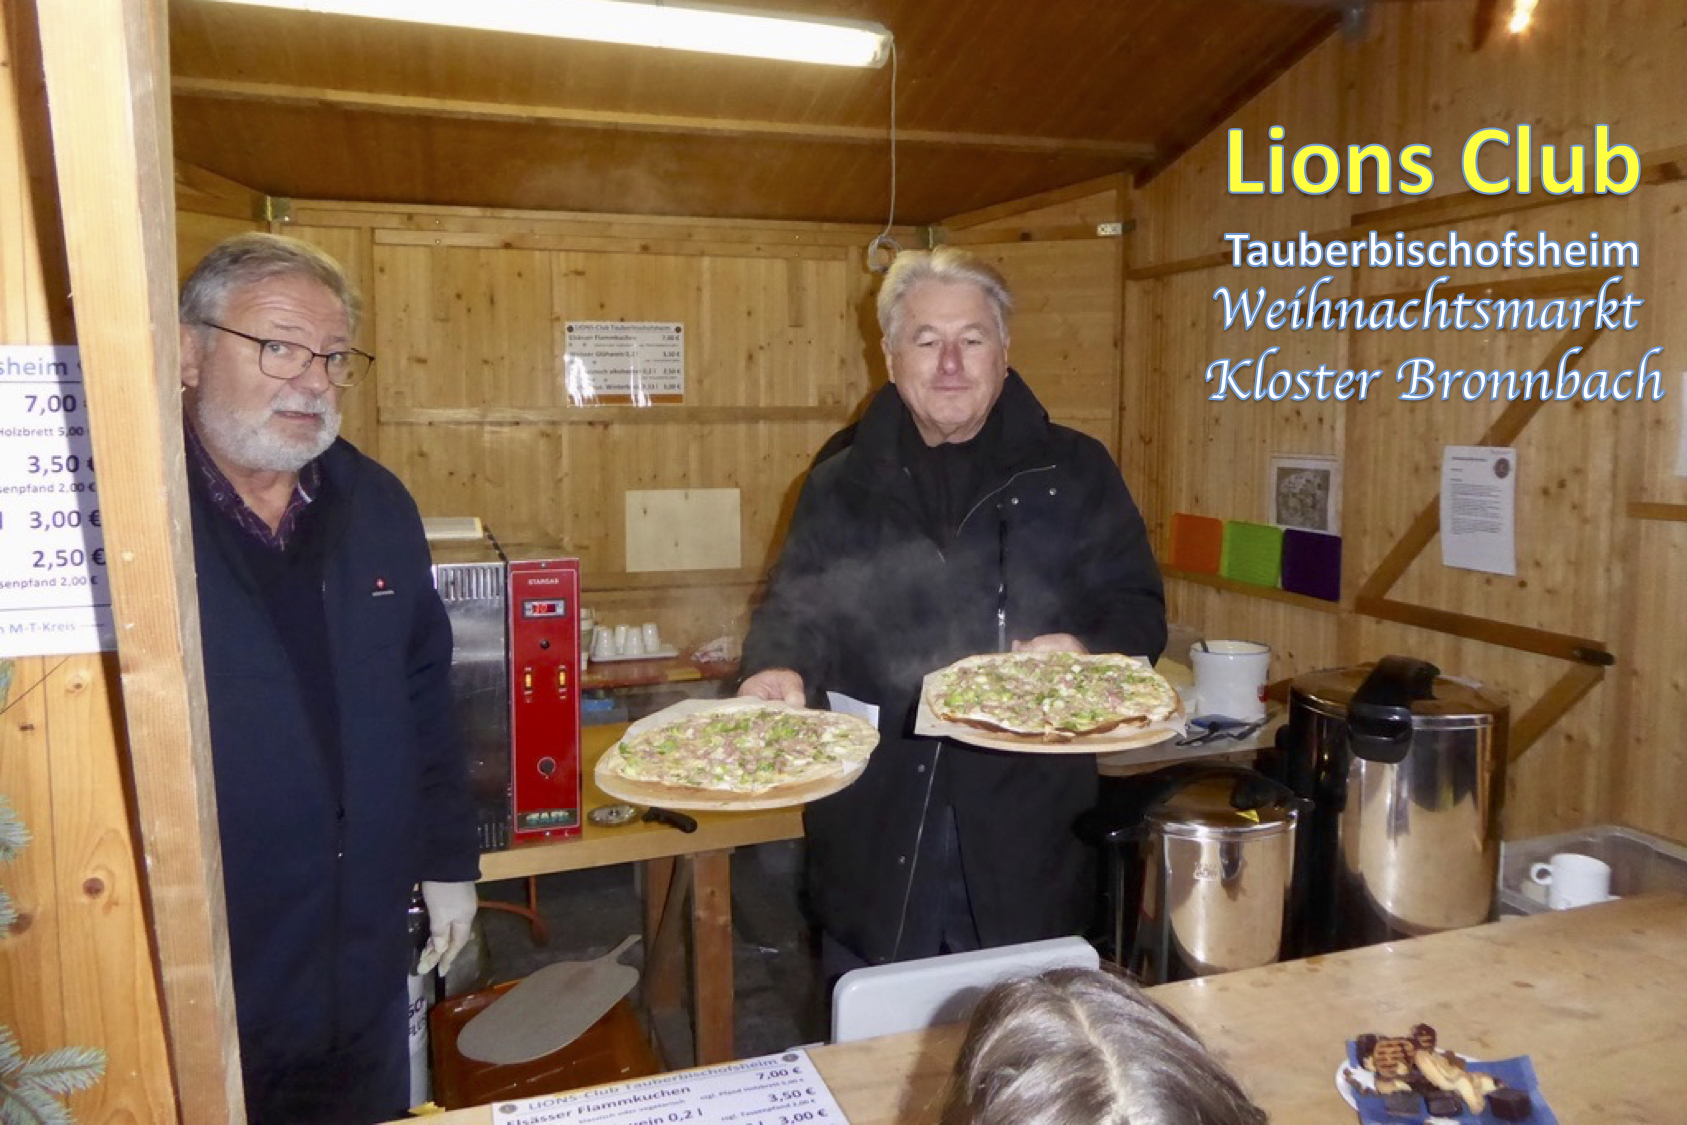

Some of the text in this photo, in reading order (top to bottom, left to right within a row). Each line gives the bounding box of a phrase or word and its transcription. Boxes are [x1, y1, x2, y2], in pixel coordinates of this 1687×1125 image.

[25, 394, 76, 416] 7,00
[58, 427, 84, 437] 5,00
[28, 455, 80, 476] 3,50
[59, 483, 84, 493] 2,00
[30, 510, 81, 532] 3,00
[89, 510, 101, 527] €
[33, 548, 106, 571] 2,50 €
[61, 577, 86, 588] 2,00
[91, 576, 98, 585] €
[10, 622, 76, 634] M-T-Kreis
[627, 1058, 778, 1090] Tauberbischofsheim
[578, 1085, 691, 1114] Flammkuchen
[756, 1068, 789, 1080] 7,00
[793, 1066, 803, 1074] €
[668, 1109, 692, 1122] 0,2
[768, 1089, 802, 1102] 3,50
[806, 1086, 817, 1096] €
[779, 1108, 829, 1125] 3,00 €
